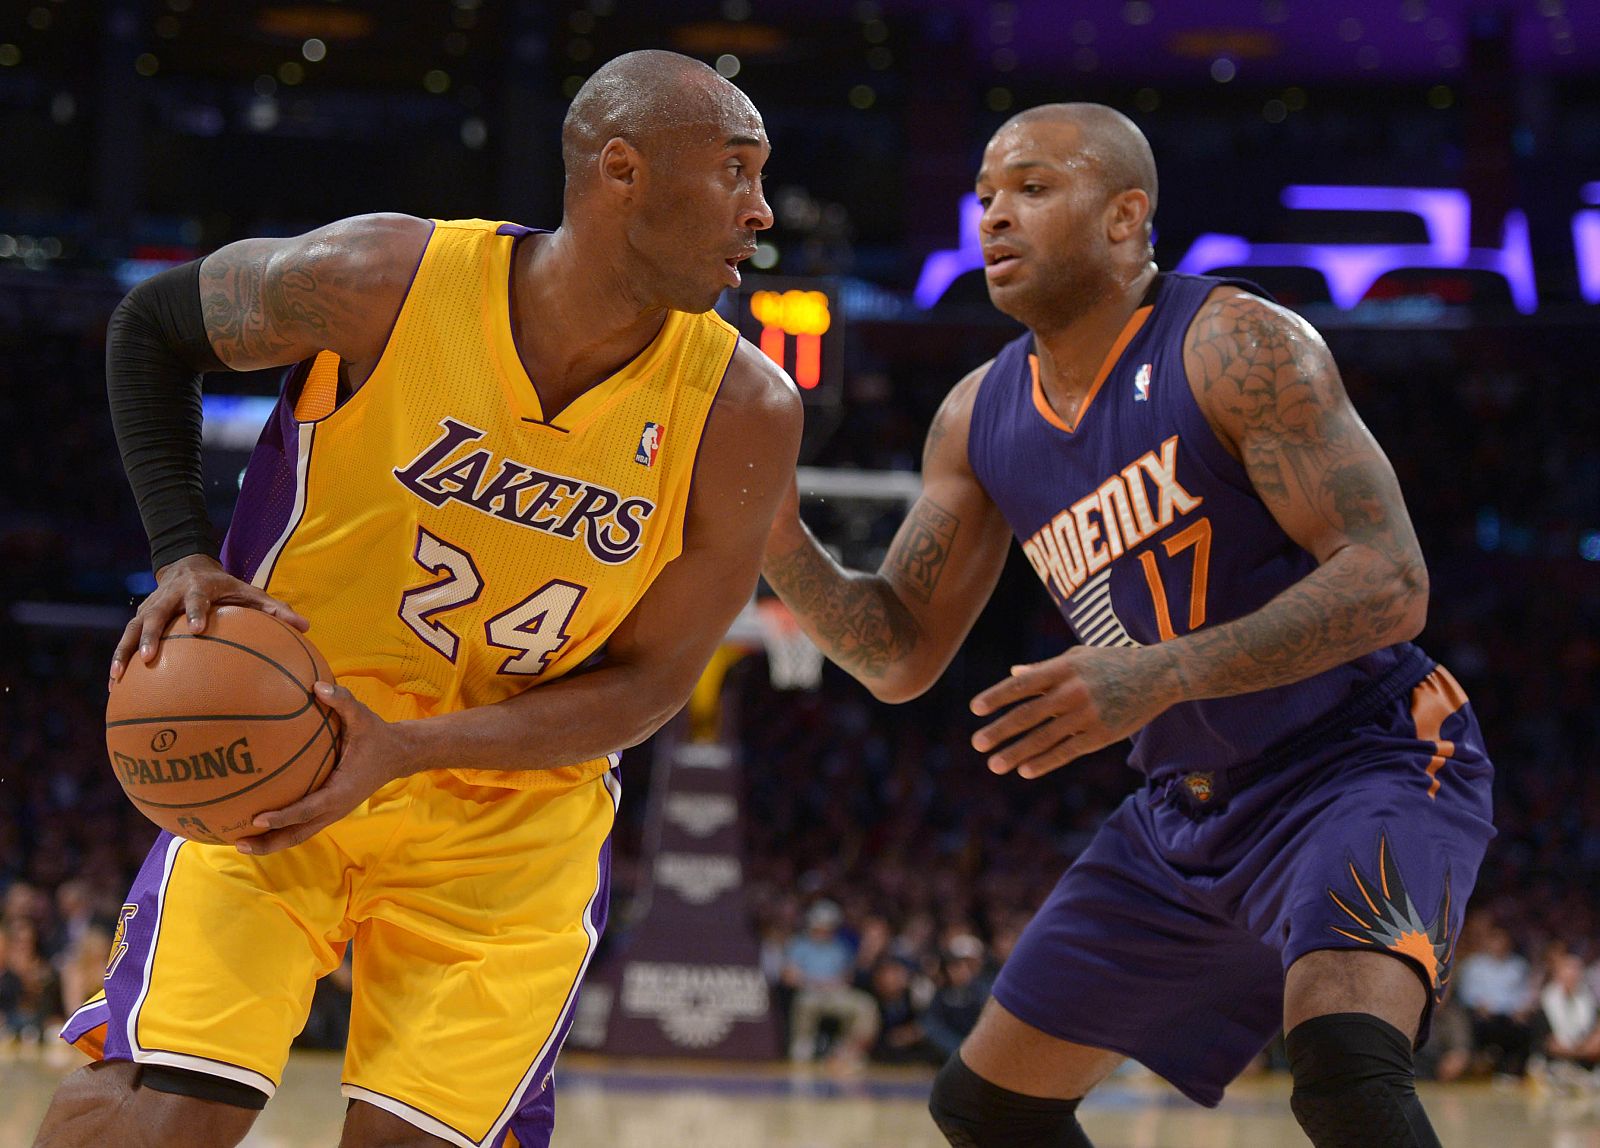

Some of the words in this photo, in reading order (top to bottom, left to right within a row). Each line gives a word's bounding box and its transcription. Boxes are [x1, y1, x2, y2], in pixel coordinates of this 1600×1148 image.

[392, 416, 656, 566] LAKERS
[1023, 434, 1204, 600] PHOENIX
[397, 524, 588, 676] 24
[1137, 517, 1213, 642] 17
[113, 737, 255, 785] SPALDING
